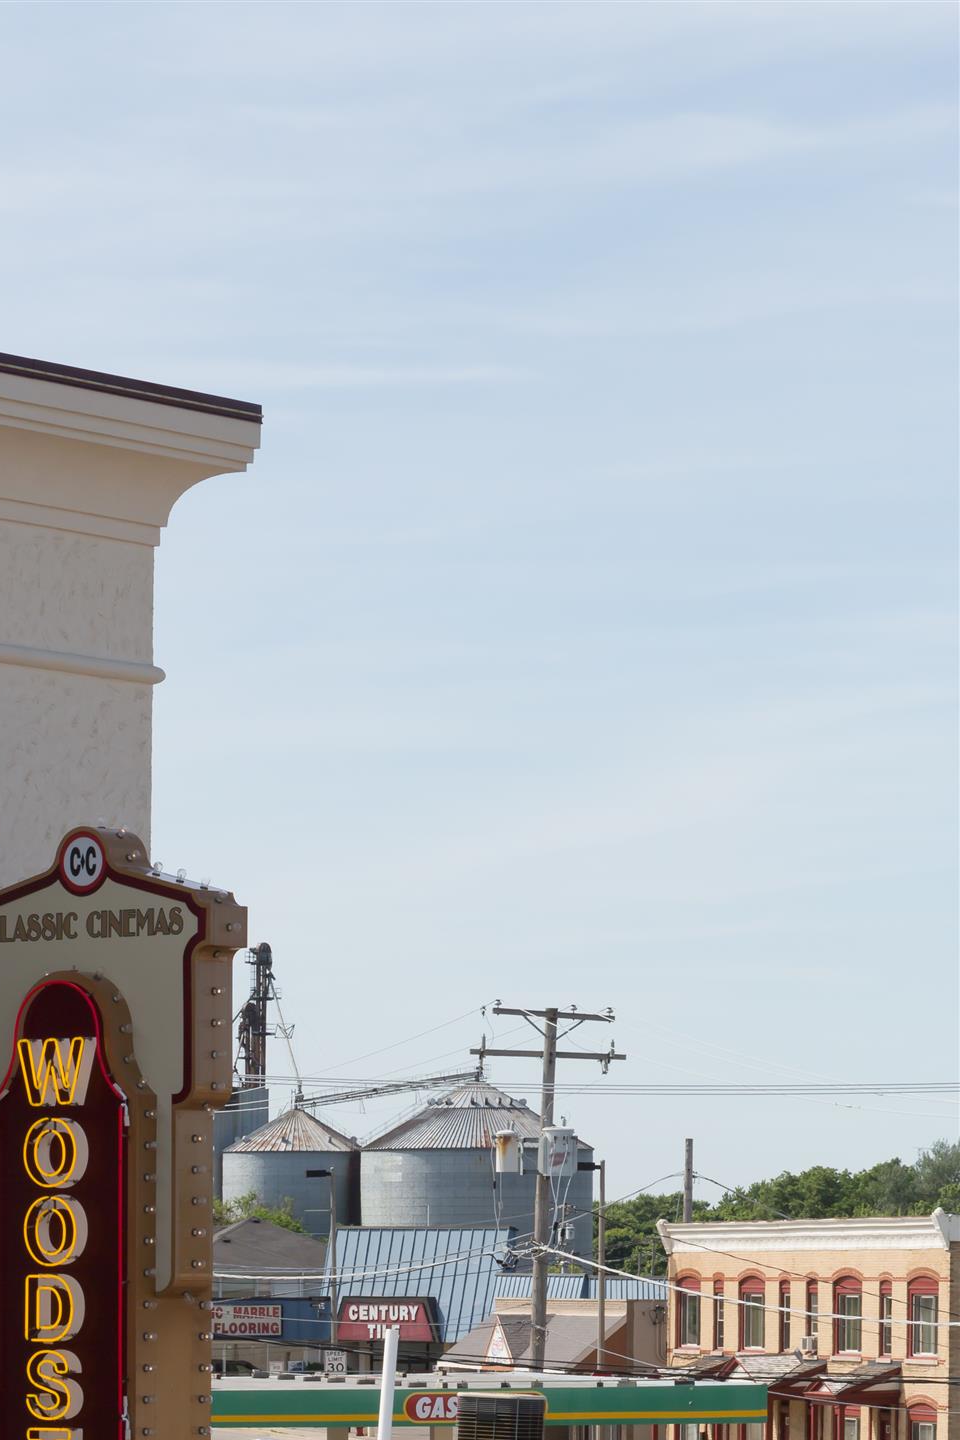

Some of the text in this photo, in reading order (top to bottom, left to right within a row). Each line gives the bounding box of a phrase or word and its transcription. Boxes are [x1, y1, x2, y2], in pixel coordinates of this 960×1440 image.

[85, 906, 185, 939] CINEMAS
[233, 1306, 280, 1319] MARBLE
[348, 1304, 419, 1321] CENTURY
[214, 1322, 280, 1335] FLOORING
[327, 1362, 345, 1373] 30
[415, 1396, 458, 1419] GAS
